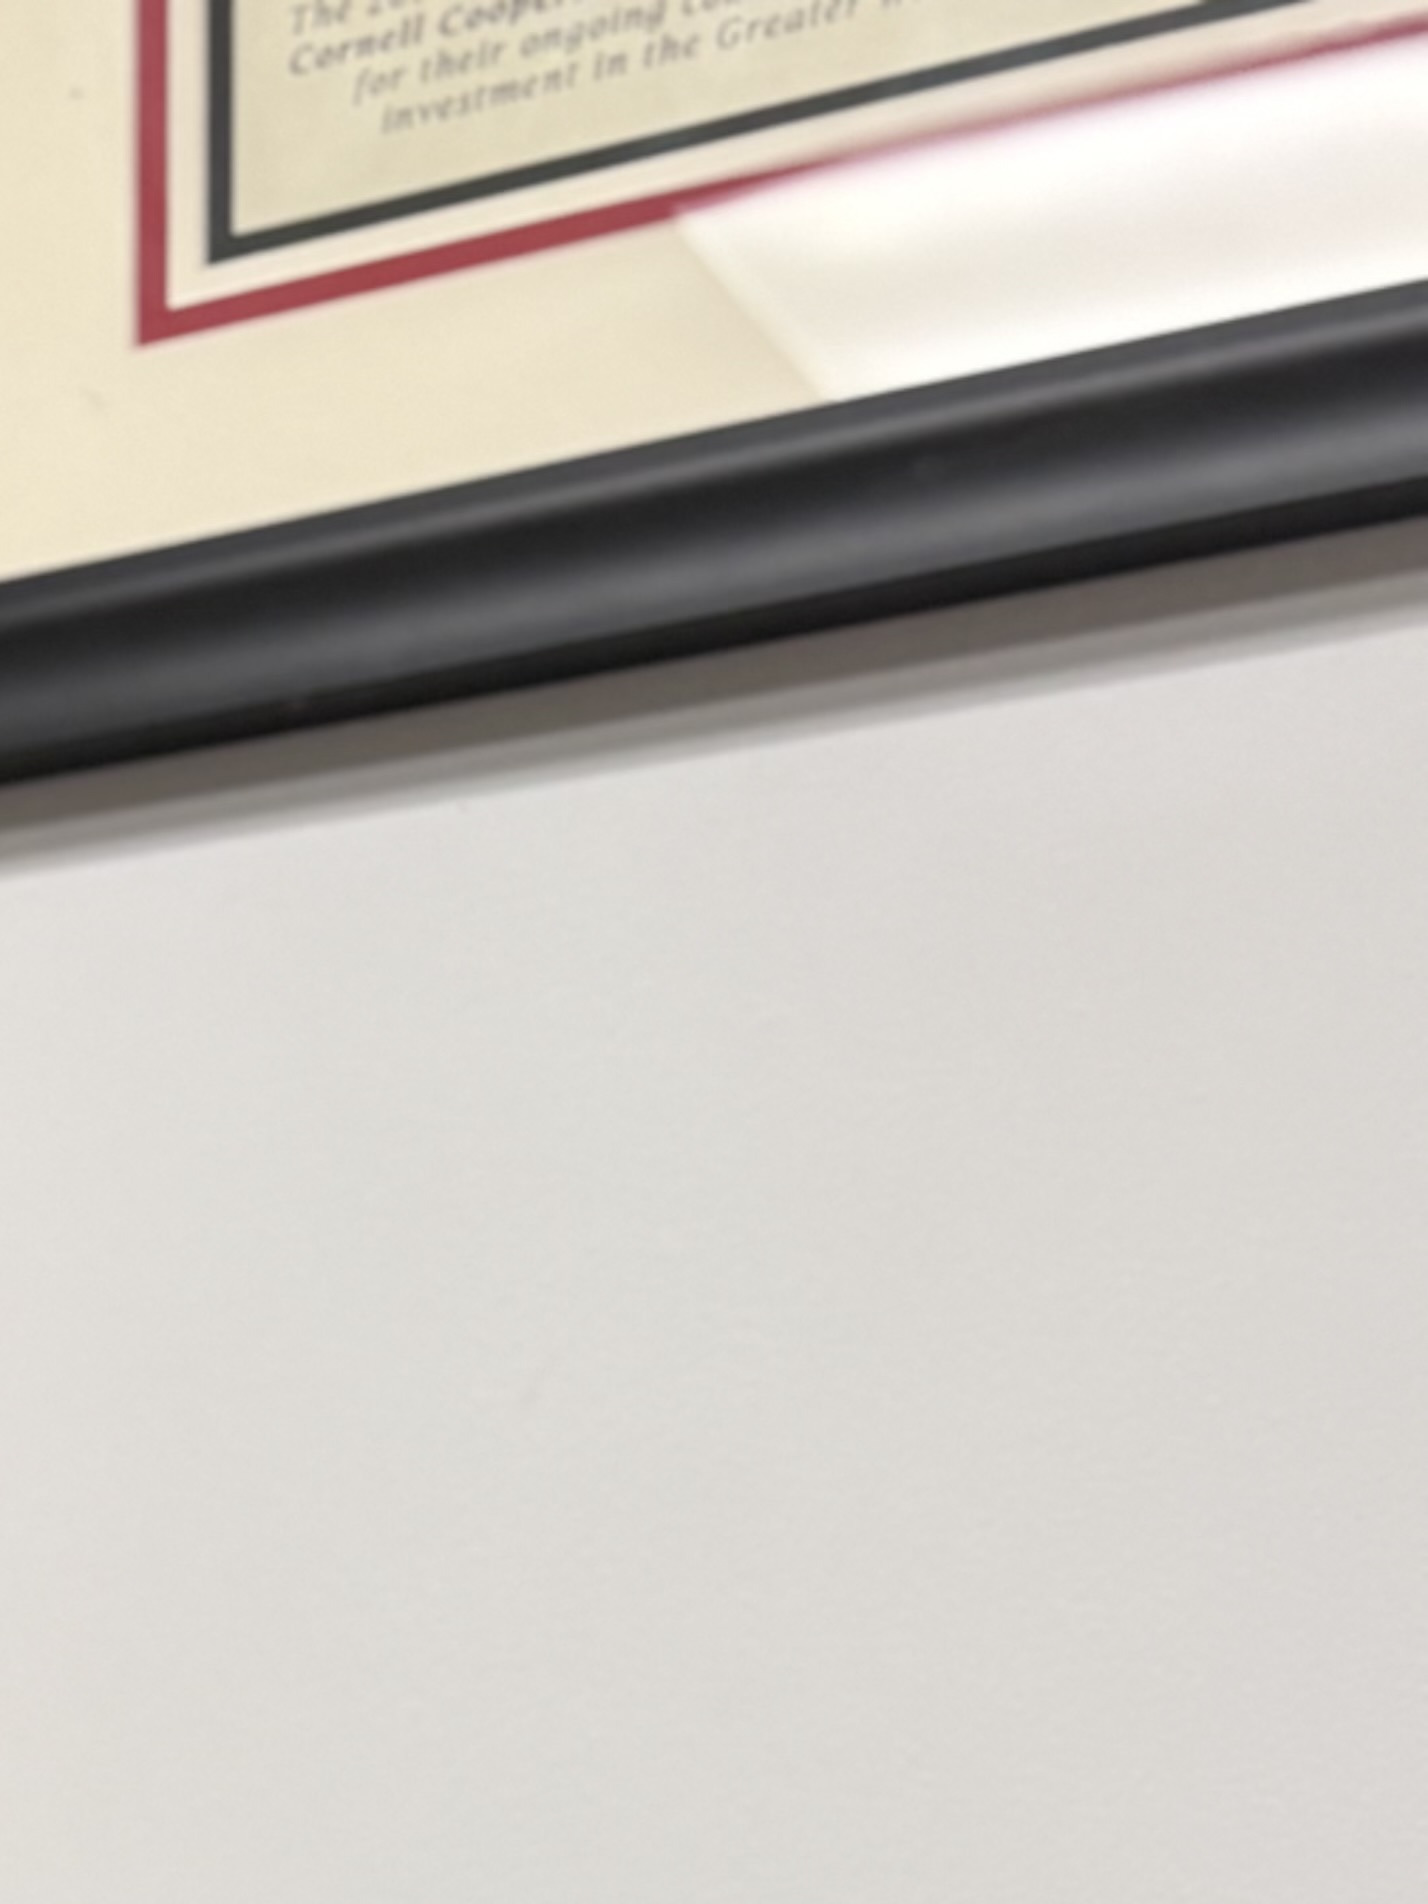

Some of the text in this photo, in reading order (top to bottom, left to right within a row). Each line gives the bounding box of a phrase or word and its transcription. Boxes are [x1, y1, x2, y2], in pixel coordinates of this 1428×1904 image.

[289, 11, 426, 76] Cornell
[351, 65, 407, 107] for
[418, 37, 507, 85] their
[380, 61, 581, 135] investment
[592, 50, 629, 82] in
[643, 31, 701, 69] the
